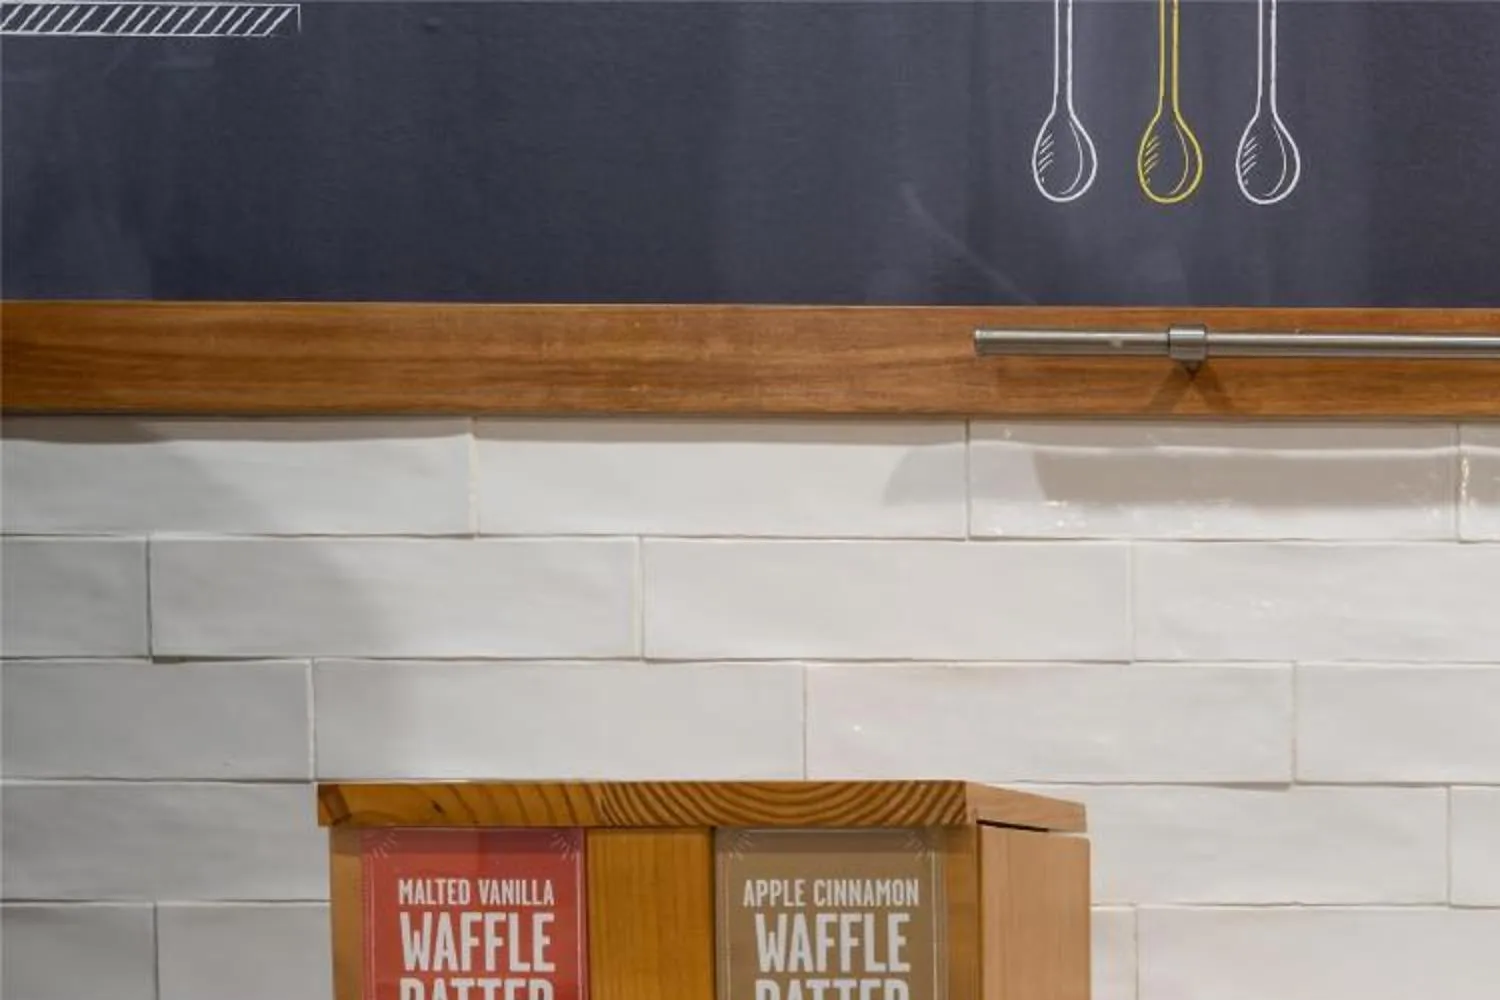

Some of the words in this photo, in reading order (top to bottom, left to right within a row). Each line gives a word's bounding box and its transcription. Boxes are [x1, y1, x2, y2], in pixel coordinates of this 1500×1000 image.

[398, 878, 470, 906] MALTED
[477, 878, 555, 906] VANILLA
[742, 878, 807, 907] APPLE
[813, 878, 920, 907] CINNAMON
[400, 911, 556, 973] WAFFLE
[755, 912, 912, 974] WAFFLE
